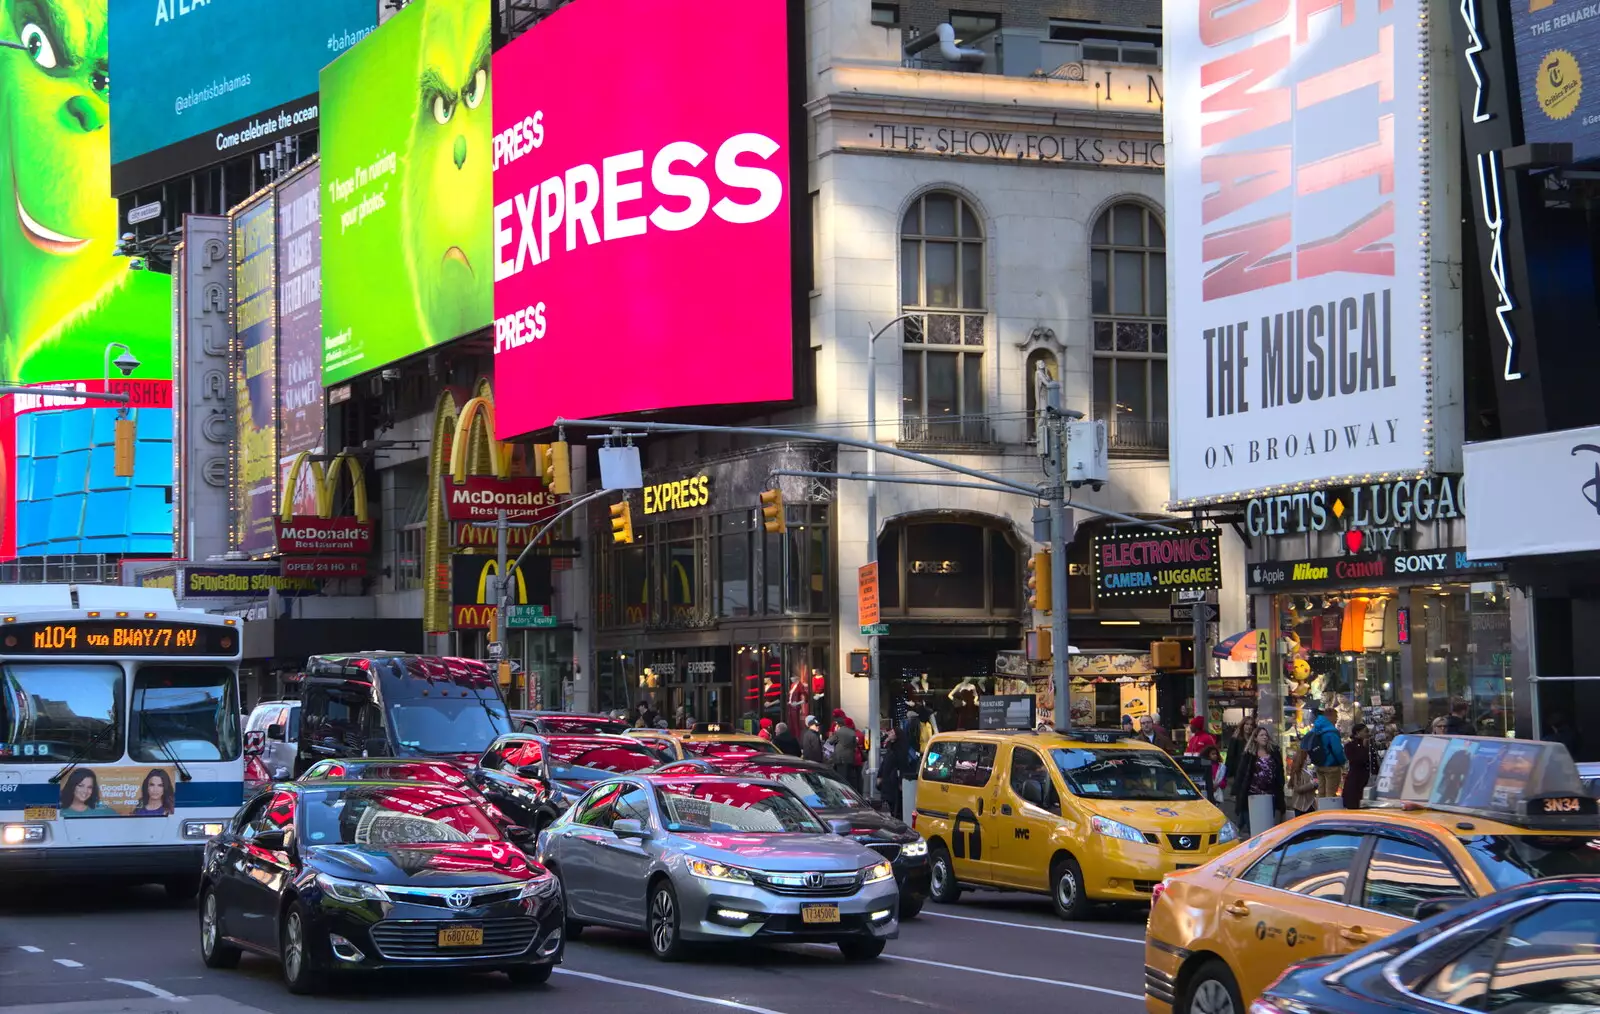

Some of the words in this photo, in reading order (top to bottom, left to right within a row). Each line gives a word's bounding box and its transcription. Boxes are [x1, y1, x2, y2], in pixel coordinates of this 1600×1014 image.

[1530, 20, 1552, 36] THE
[175, 72, 251, 114] @atlantisbahamas
[216, 133, 240, 150] Come
[240, 122, 277, 142] celebrate
[278, 110, 292, 130] the
[293, 105, 318, 124] ocean
[492, 109, 544, 172] PRESS
[874, 125, 926, 150] THE
[937, 128, 1012, 155] SHOW
[1027, 135, 1104, 162] FOLKS
[494, 133, 783, 282] EXPRESS
[494, 301, 547, 355] PRESS
[1203, 321, 1249, 418] THE
[1261, 289, 1396, 409] MUSICAL
[1205, 444, 1235, 471] ON
[1249, 418, 1400, 465] BROADWAY
[452, 489, 556, 505] McDonald's
[643, 475, 709, 515] EXPRESS
[470, 506, 539, 516] Resturant
[1246, 491, 1327, 537] GIFTS
[281, 527, 369, 540] McDonald's
[1365, 526, 1395, 552] NY
[295, 541, 354, 549] Restaurant
[1101, 538, 1211, 568] ELECTRONICS
[287, 563, 314, 571] OPEN
[316, 563, 328, 571] 24
[1292, 562, 1328, 581] Nikon
[1335, 559, 1386, 579] Canon
[1394, 553, 1447, 573] SONY
[190, 573, 249, 591] SPONGEBOB
[1104, 572, 1152, 589] CAMERA
[1158, 567, 1213, 585] LUGGAGE
[1262, 568, 1285, 584] Apple
[526, 606, 535, 615] 46
[534, 616, 553, 625] Equity
[34, 626, 77, 649] M104
[87, 634, 109, 646] VIA
[113, 628, 172, 647] BWAY/7
[176, 629, 197, 647] AV
[862, 655, 869, 671] 5
[1259, 631, 1269, 676] ATM
[687, 661, 716, 674] EXPRESS
[1094, 734, 1109, 743] 9N42
[1543, 798, 1580, 812] 3N34
[1014, 827, 1030, 840] NYC
